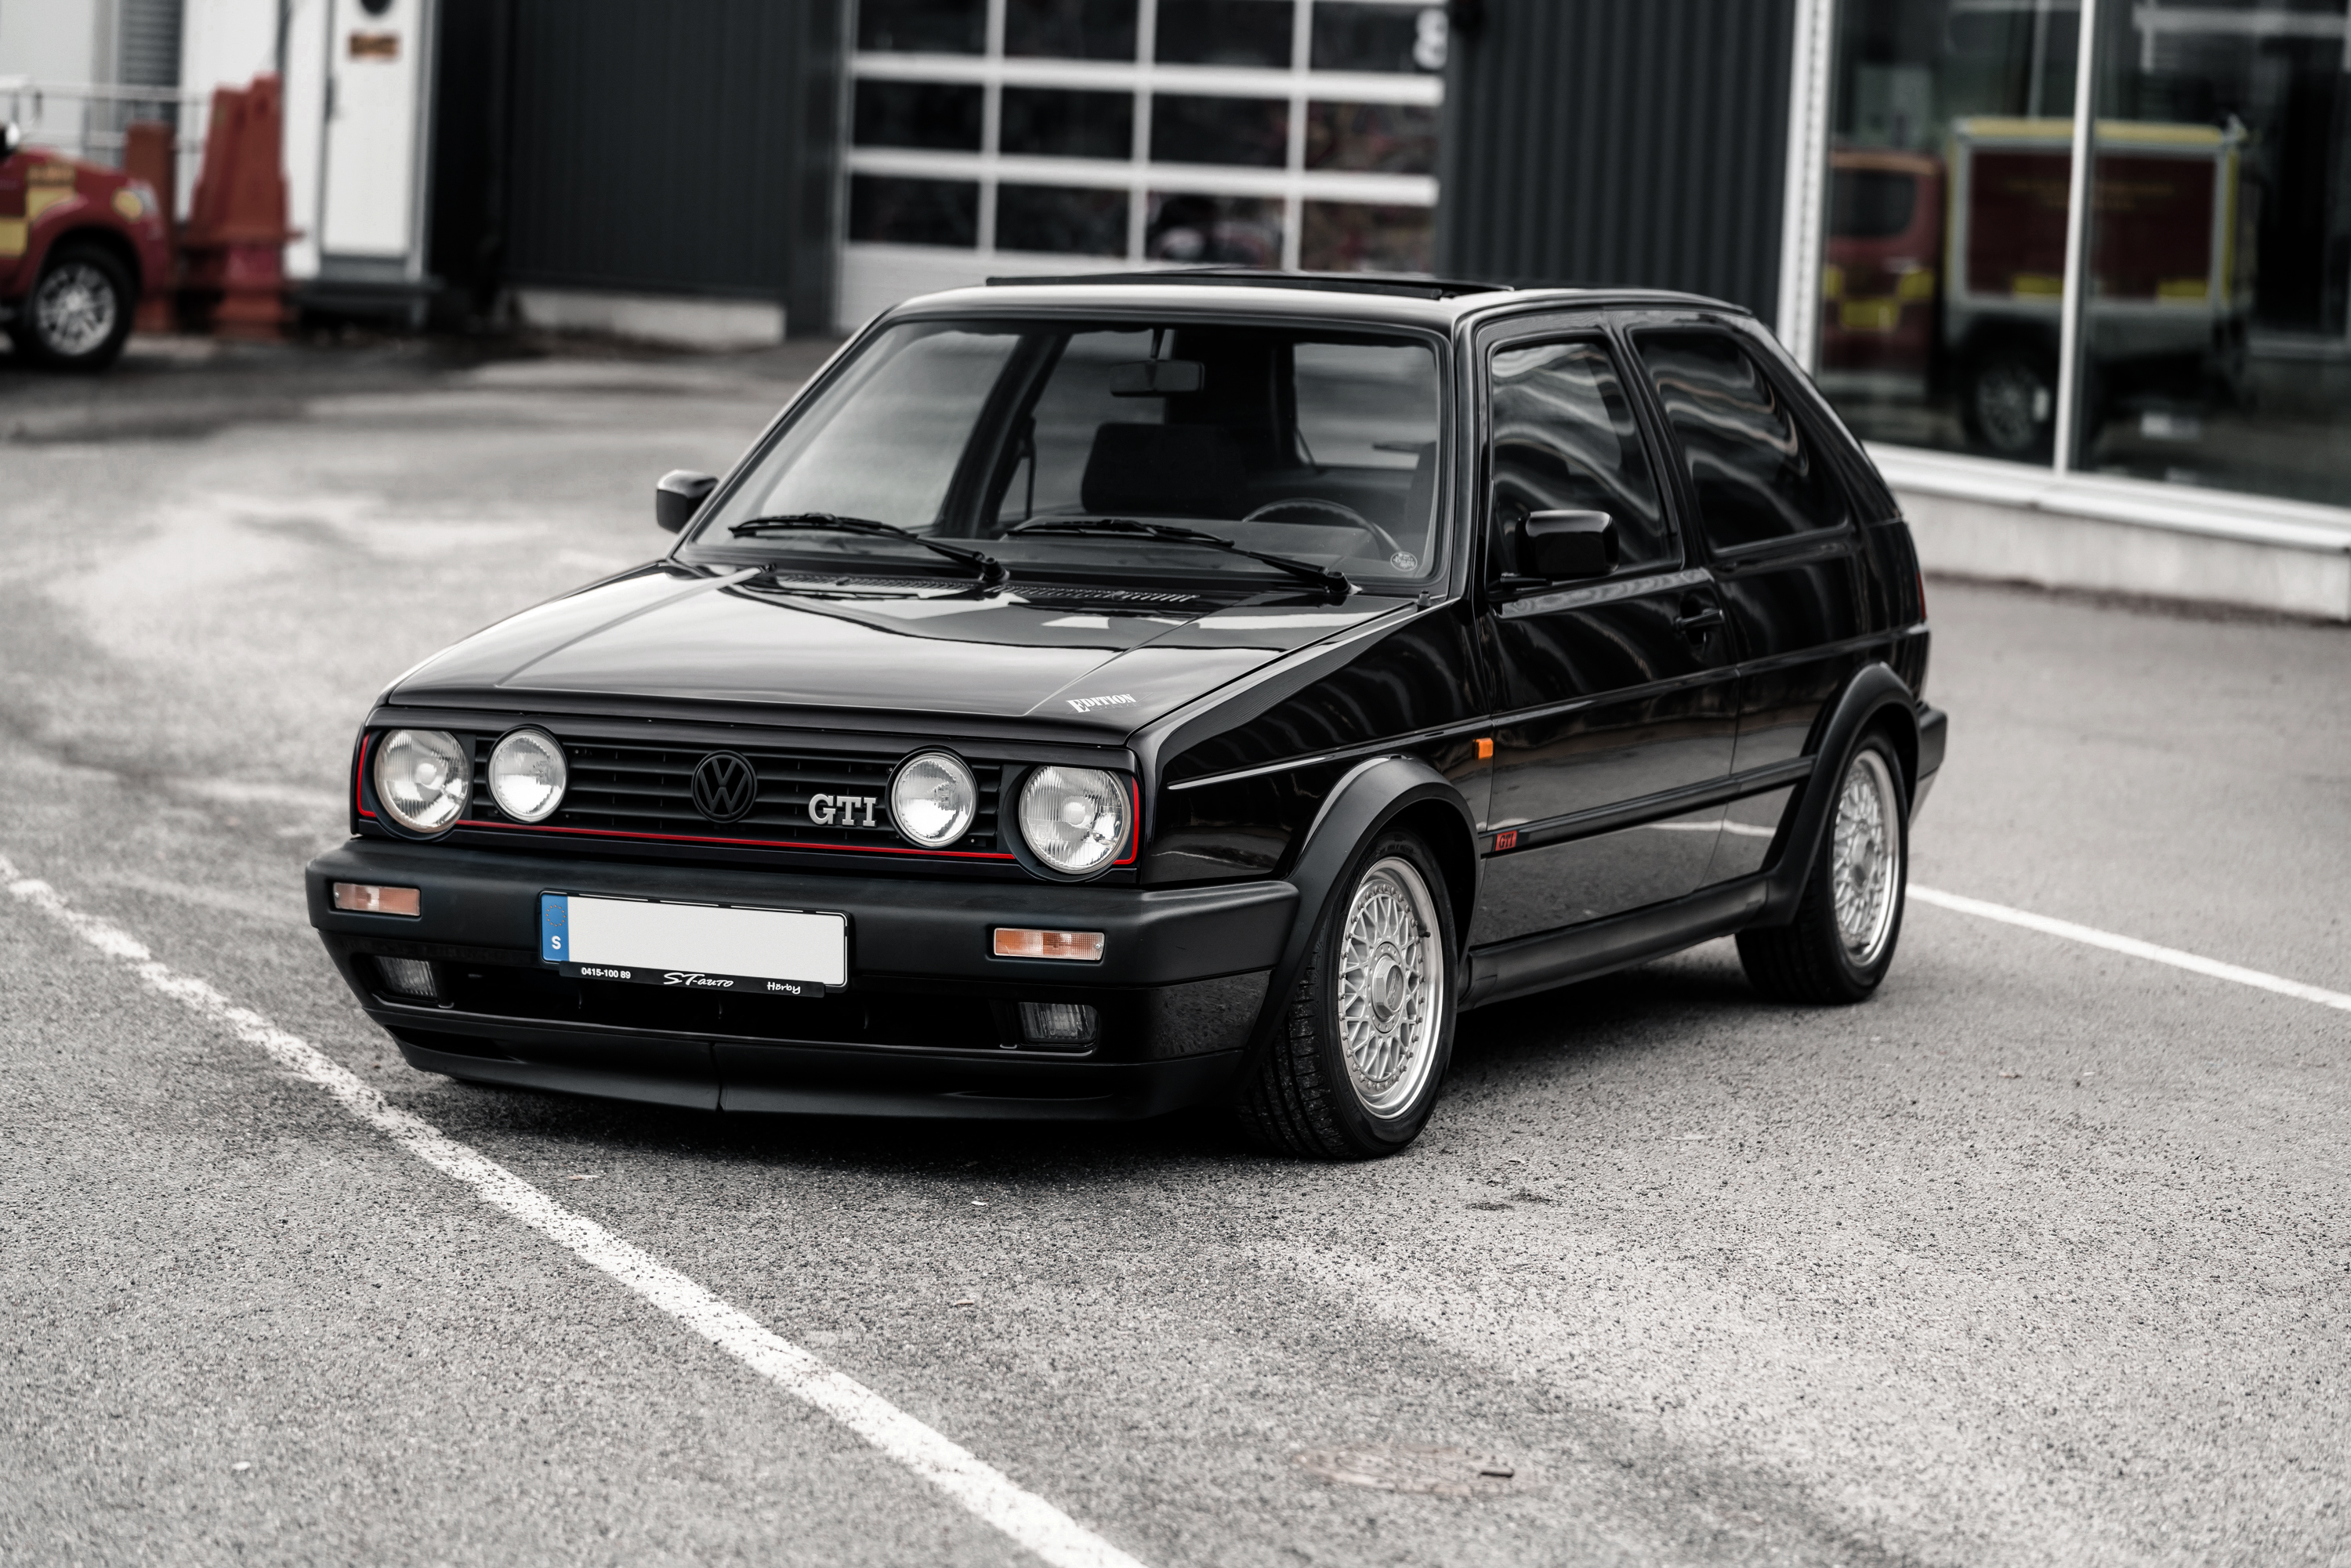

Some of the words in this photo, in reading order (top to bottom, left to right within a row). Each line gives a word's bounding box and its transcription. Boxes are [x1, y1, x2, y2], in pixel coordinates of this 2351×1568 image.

[1066, 693, 1137, 713] EDITION
[808, 793, 878, 827] GTI
[1498, 832, 1514, 849] GTI
[551, 935, 562, 951] S
[581, 967, 619, 978] 0415-100
[620, 970, 632, 980] 89
[766, 981, 801, 995] Hörby
